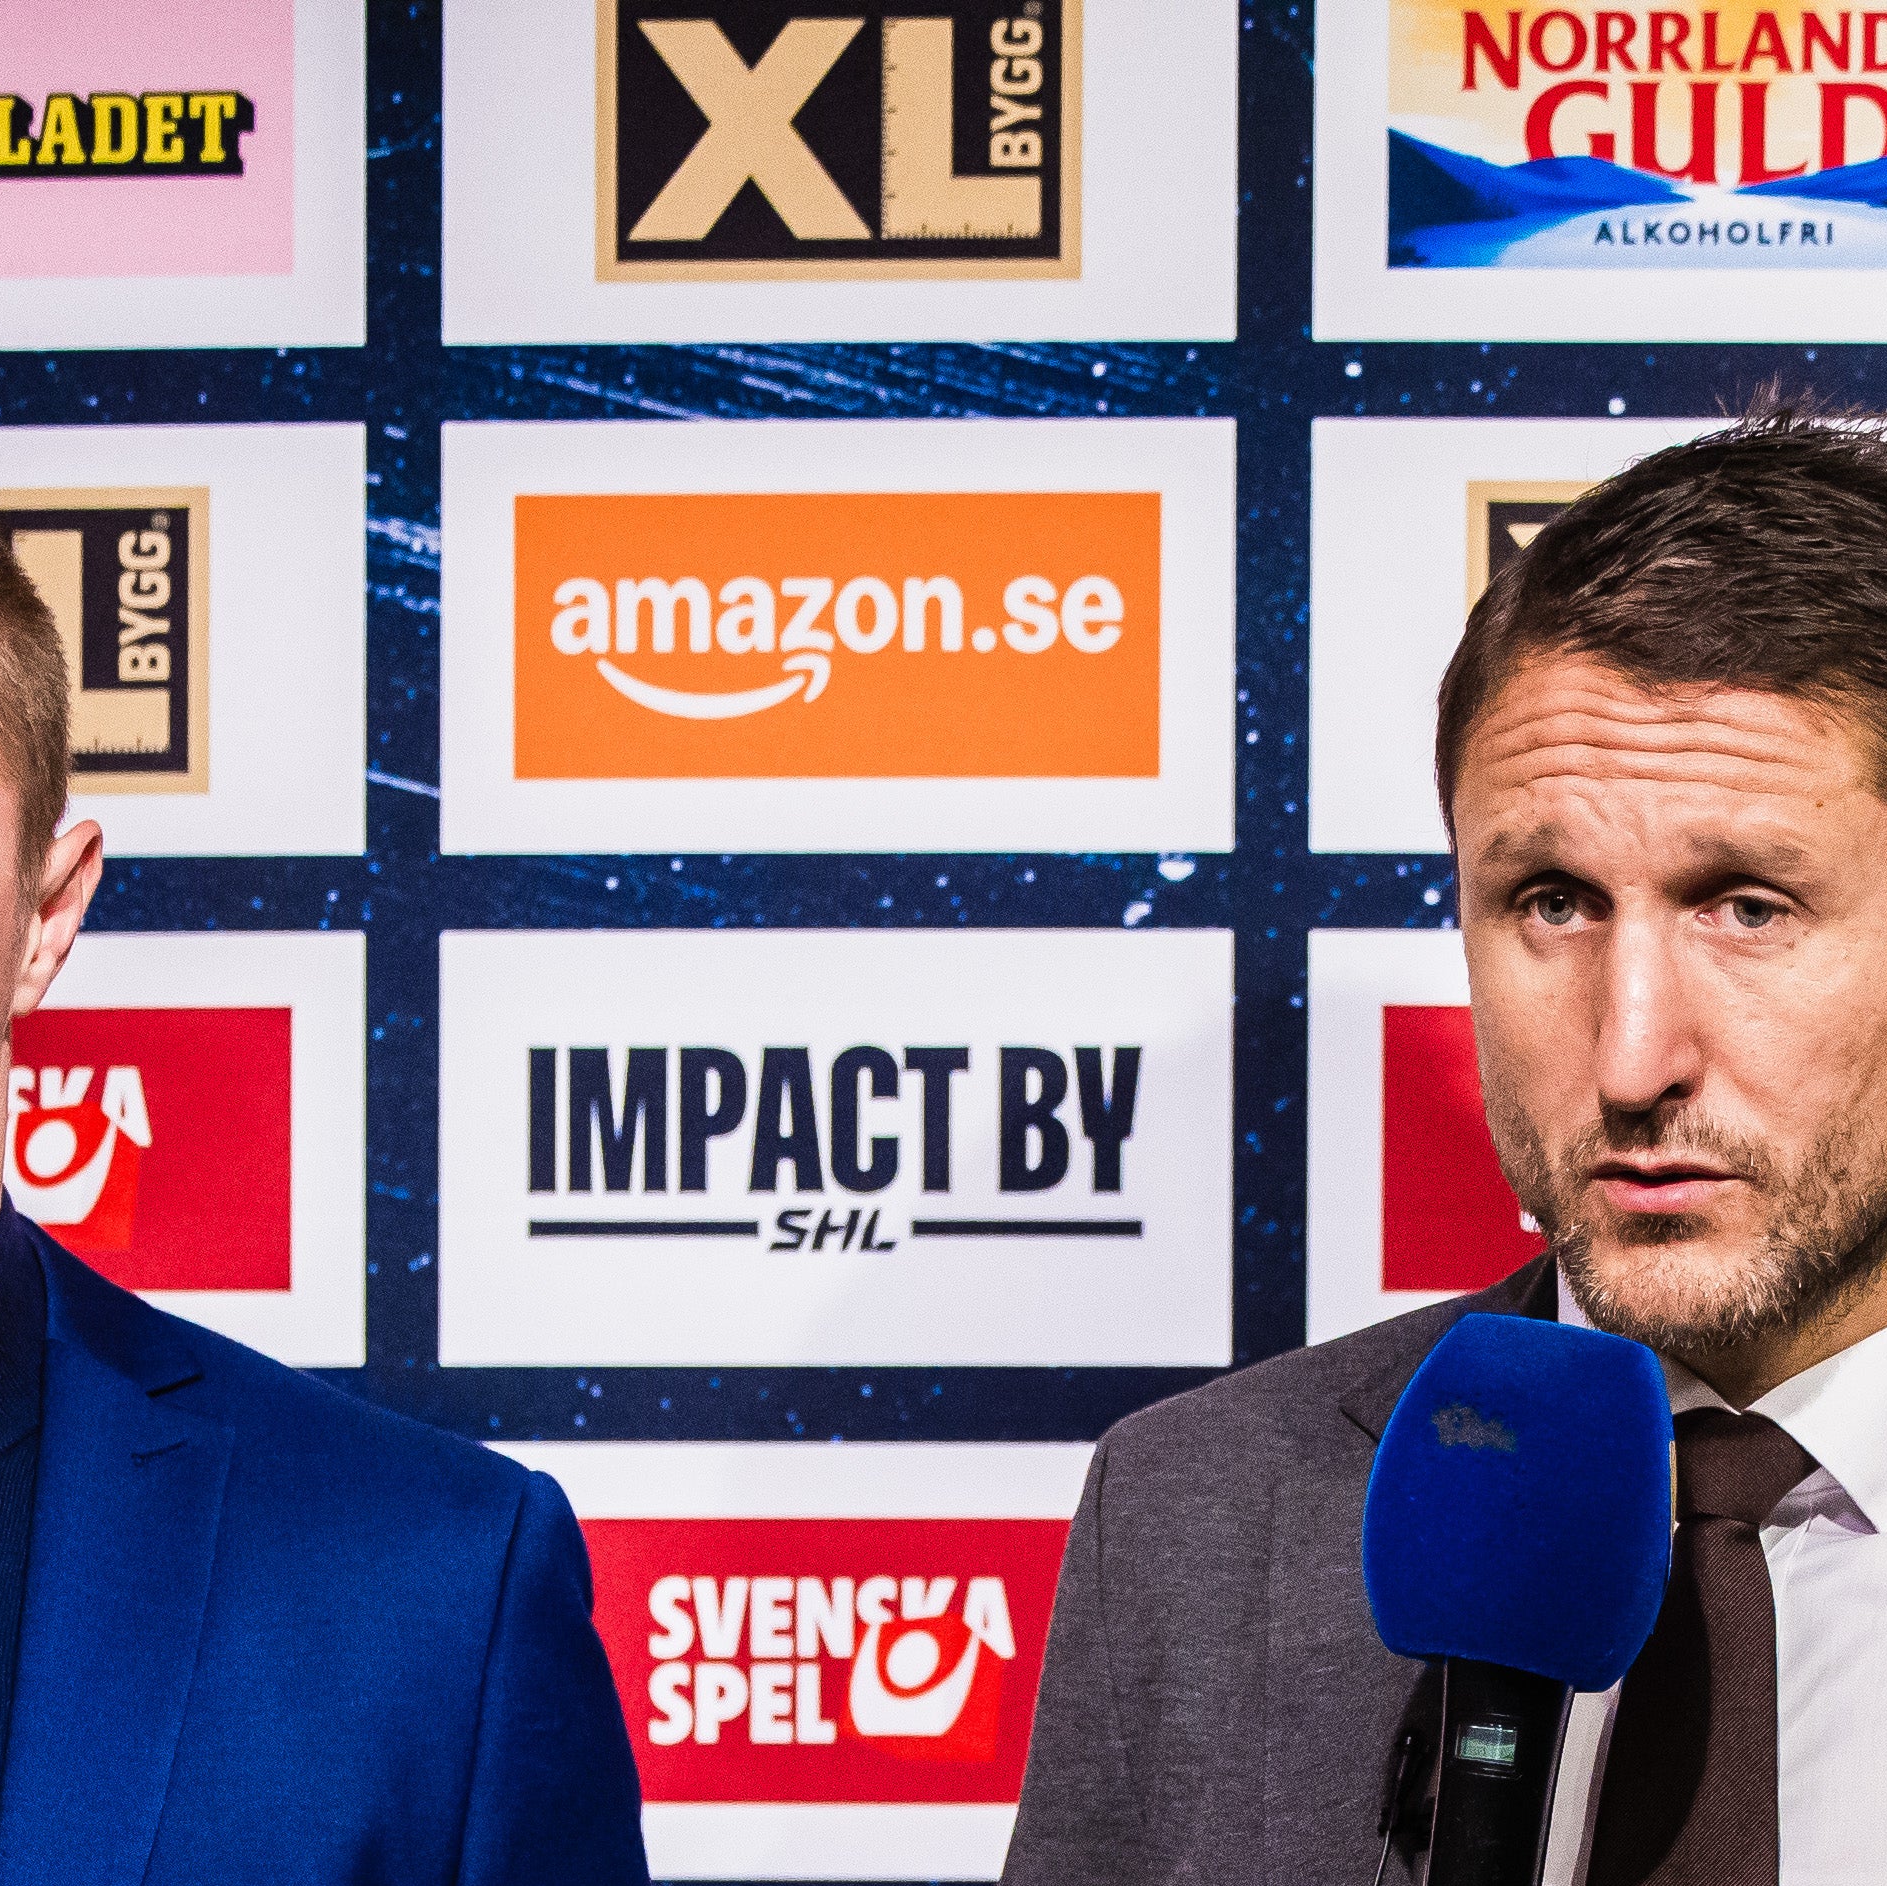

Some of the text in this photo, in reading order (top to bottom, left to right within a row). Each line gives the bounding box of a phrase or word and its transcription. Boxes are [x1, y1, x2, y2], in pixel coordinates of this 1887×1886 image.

[627, 17, 1042, 241] XL
[989, 17, 1044, 168] BYGG
[1594, 220, 1836, 246] ALKOHOLFRI
[118, 529, 171, 681] BYGG
[550, 575, 1124, 656] amazon.se
[529, 1044, 1142, 1194] IMPACT BY
[770, 1209, 895, 1252] SHL
[647, 1574, 1016, 1660] SVENSKA
[647, 1661, 838, 1745] SPEL
